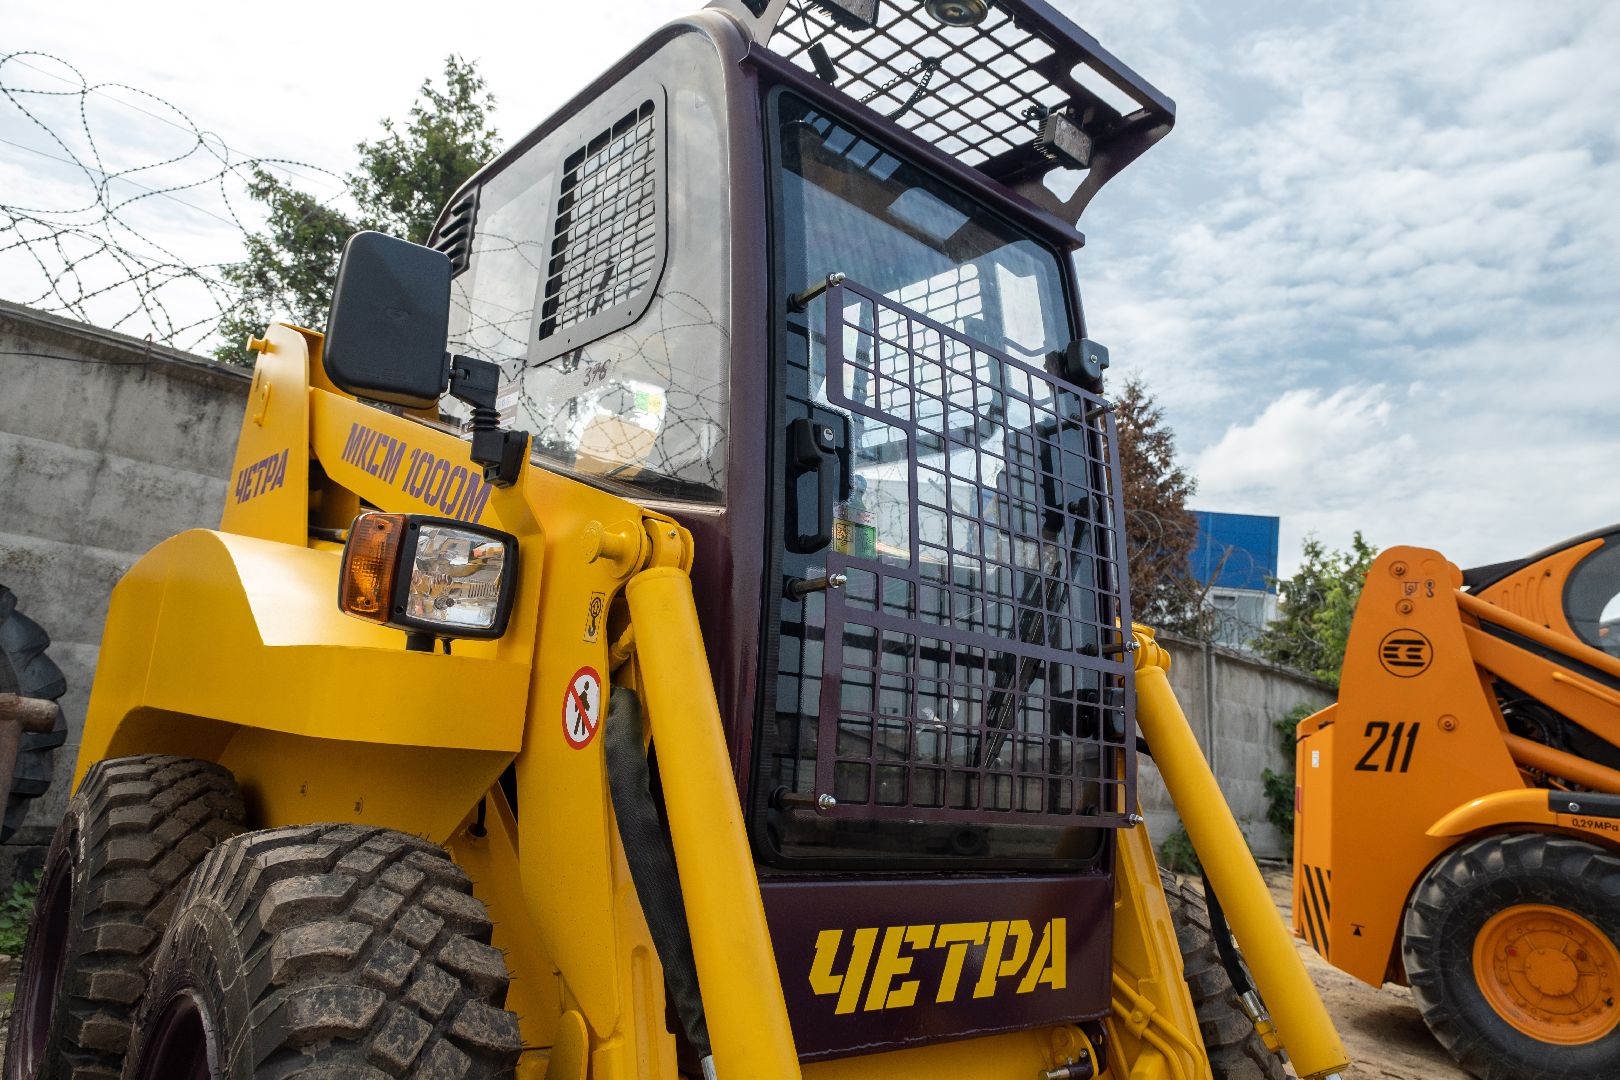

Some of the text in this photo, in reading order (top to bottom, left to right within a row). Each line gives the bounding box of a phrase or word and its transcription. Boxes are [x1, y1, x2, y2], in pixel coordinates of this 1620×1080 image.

[235, 448, 289, 504] ЧЕТРА
[341, 423, 492, 523] МКСМ 1000М
[1354, 721, 1420, 773] 211
[808, 918, 1067, 1015] ЧЕТРА
